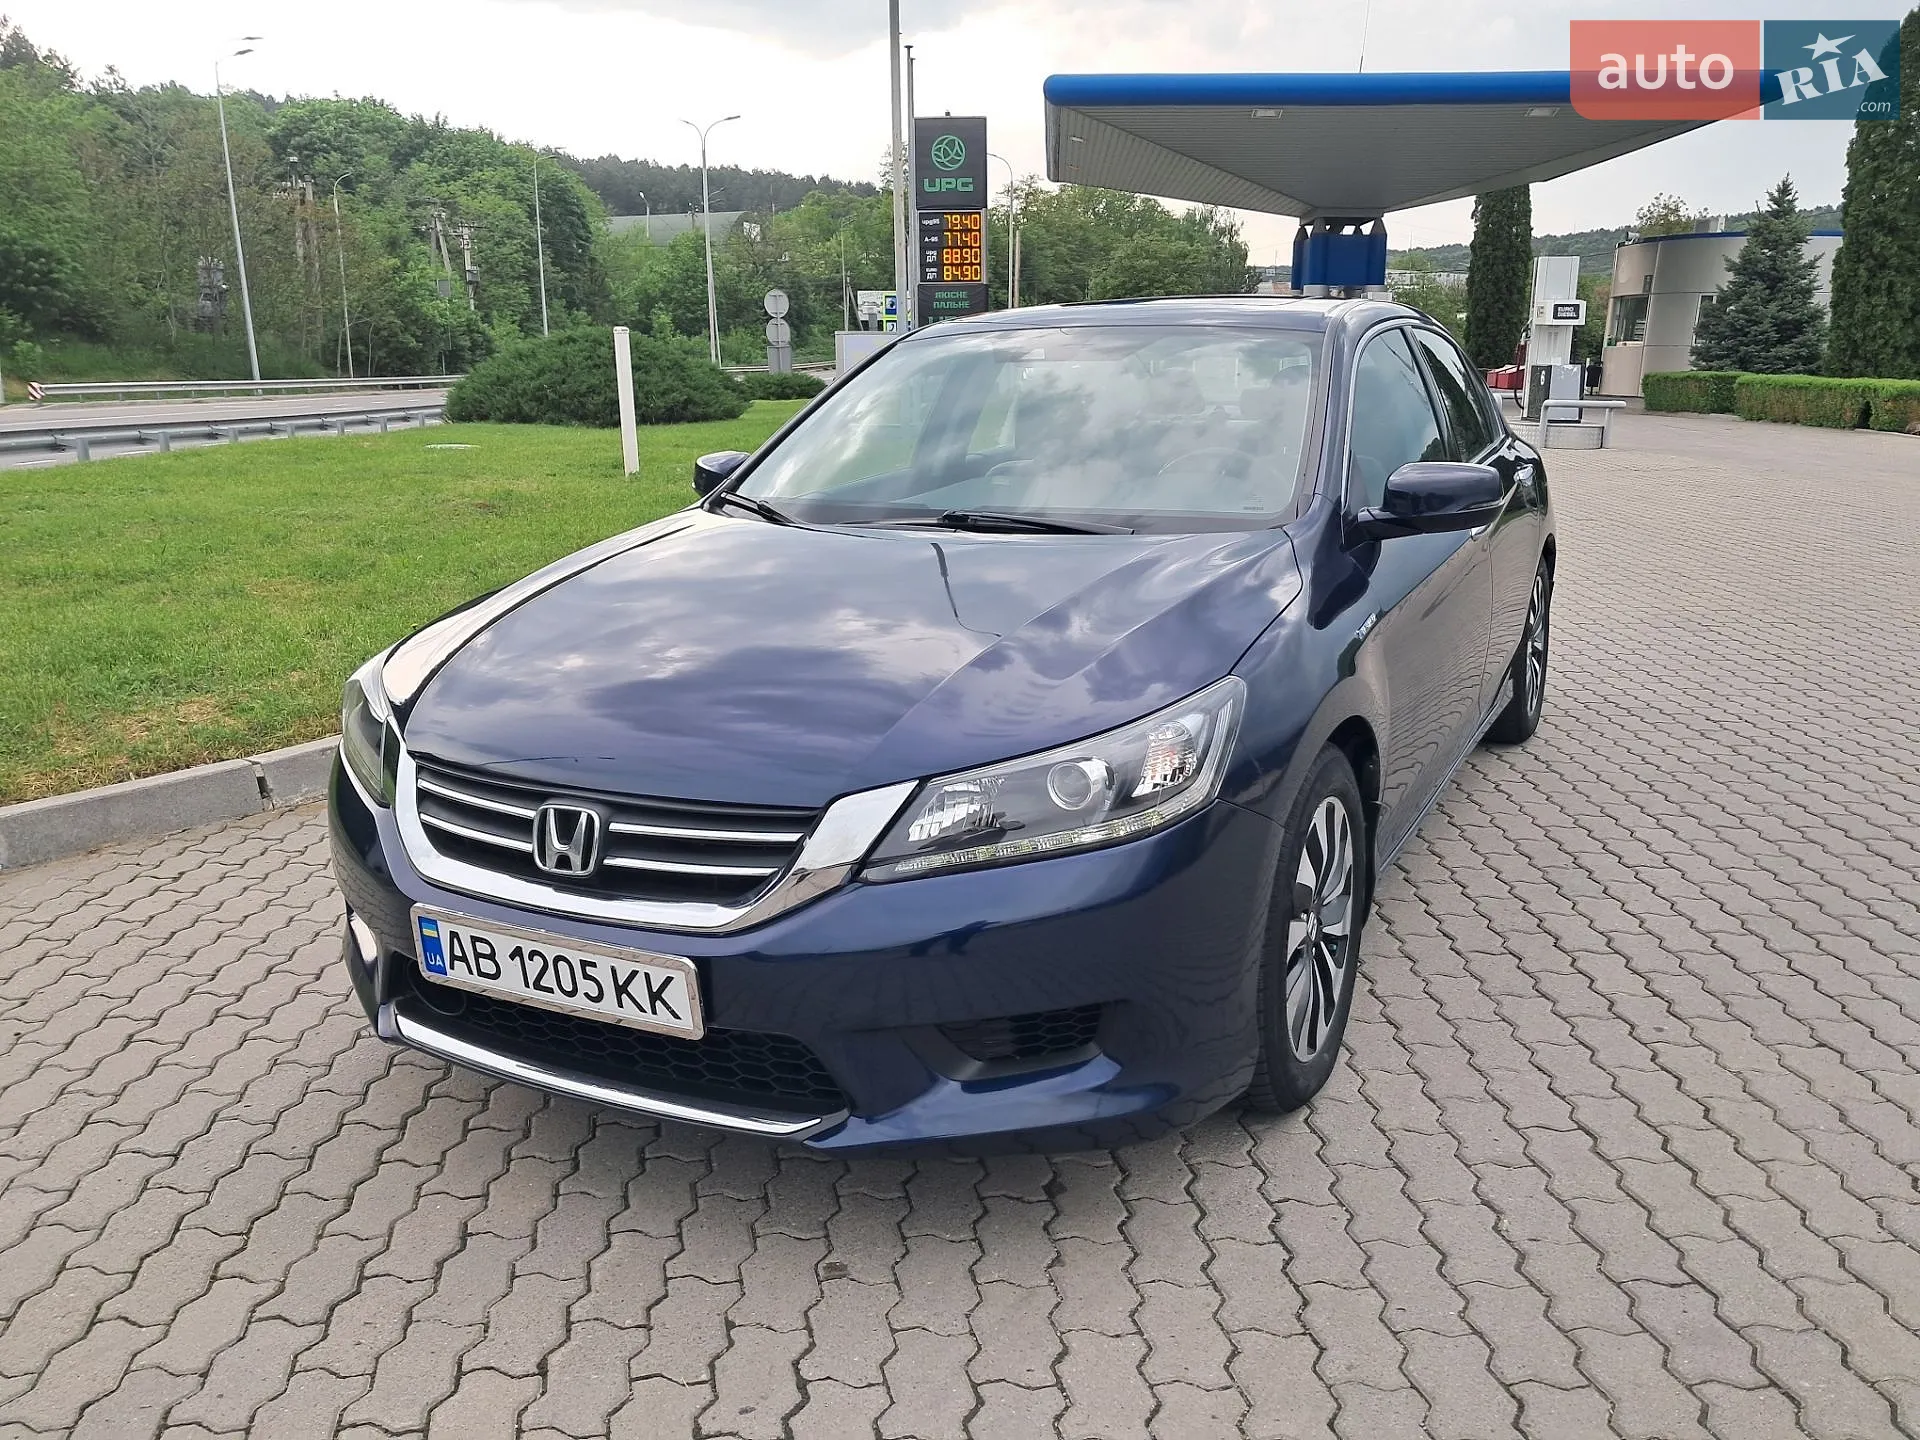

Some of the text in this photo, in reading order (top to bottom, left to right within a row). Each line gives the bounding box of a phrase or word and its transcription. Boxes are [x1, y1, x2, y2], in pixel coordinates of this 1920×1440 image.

[923, 178, 974, 192] UPG
[943, 214, 980, 230] 79.40
[943, 231, 980, 247] 77.40
[943, 248, 980, 264] 88.90
[943, 265, 981, 281] 84.90
[933, 301, 970, 309] ПАЛЬНЕ
[1540, 370, 1546, 386] 6
[426, 953, 445, 968] UA
[448, 929, 683, 1021] AB 1205 KK
